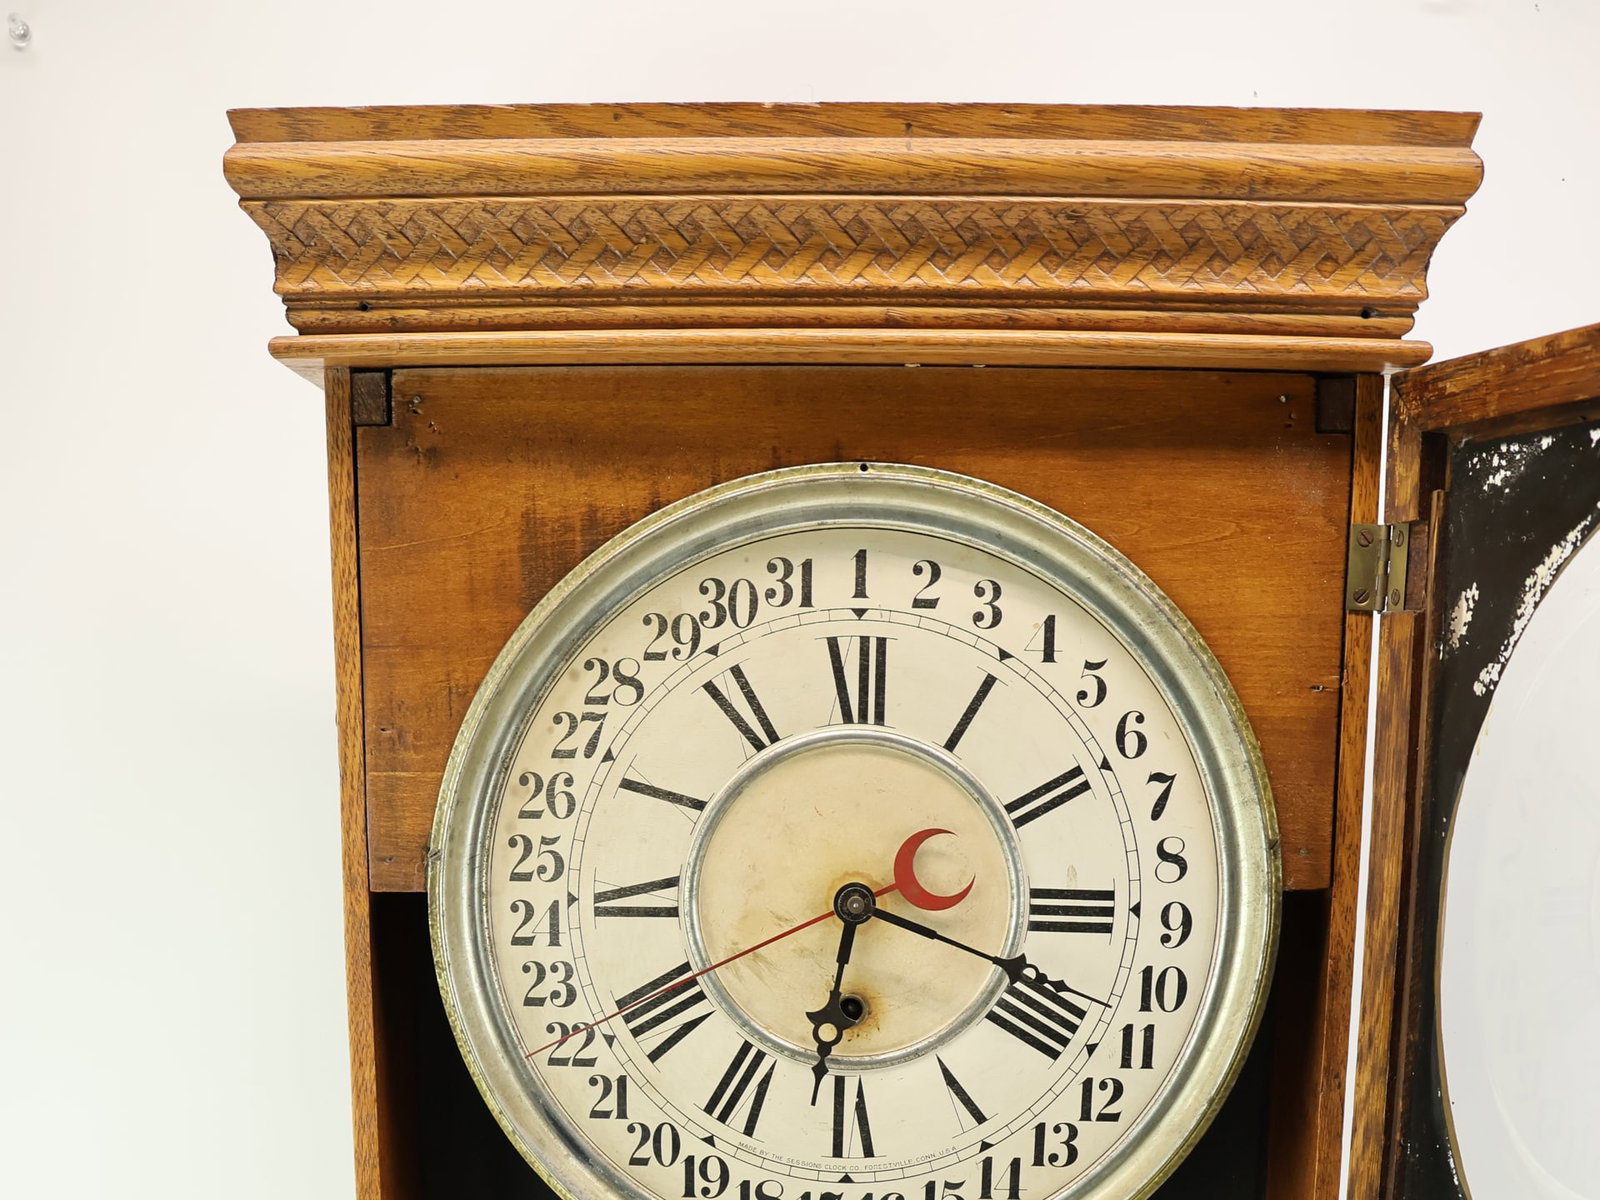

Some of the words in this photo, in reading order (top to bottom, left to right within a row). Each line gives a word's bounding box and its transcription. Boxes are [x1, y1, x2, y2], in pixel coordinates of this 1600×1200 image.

[765, 556, 814, 608] 31
[850, 549, 869, 599] 1
[912, 559, 941, 609] 2
[698, 577, 759, 629] 30
[972, 579, 1002, 630] 3
[642, 612, 701, 661] 29
[1024, 614, 1063, 663] 4
[583, 657, 645, 706] 28
[815, 636, 898, 728] XII
[1076, 658, 1108, 708] 5
[550, 711, 609, 759] 27
[692, 657, 793, 768] XI
[933, 666, 1008, 759] I
[1115, 710, 1147, 760] 6
[517, 771, 577, 820] 26
[613, 754, 715, 835] X
[997, 754, 1096, 841] II
[1146, 771, 1177, 821] 7
[507, 833, 565, 883] 25
[1154, 836, 1188, 883] 8
[593, 865, 683, 929] IX
[1024, 875, 1116, 945] III
[509, 899, 566, 947] 24
[1160, 901, 1193, 949] 9
[521, 960, 577, 1008] 23
[1137, 965, 1188, 1013] 10
[610, 949, 716, 1072] VIII
[977, 980, 1104, 1069] IIII
[546, 1022, 598, 1067] 22
[1118, 1023, 1155, 1070] 11
[588, 1074, 629, 1119] 21
[694, 1032, 777, 1142] VII
[936, 1054, 998, 1138] V
[1078, 1077, 1124, 1123] 12
[820, 1074, 887, 1159] VI
[626, 1122, 681, 1168] 20
[738, 1141, 758, 1154] MADE
[771, 1153, 784, 1161] THE
[786, 1157, 822, 1169] SESSIONS
[1030, 1122, 1079, 1168] 13
[680, 1155, 730, 1199] 19
[977, 1156, 1027, 1200] 14
